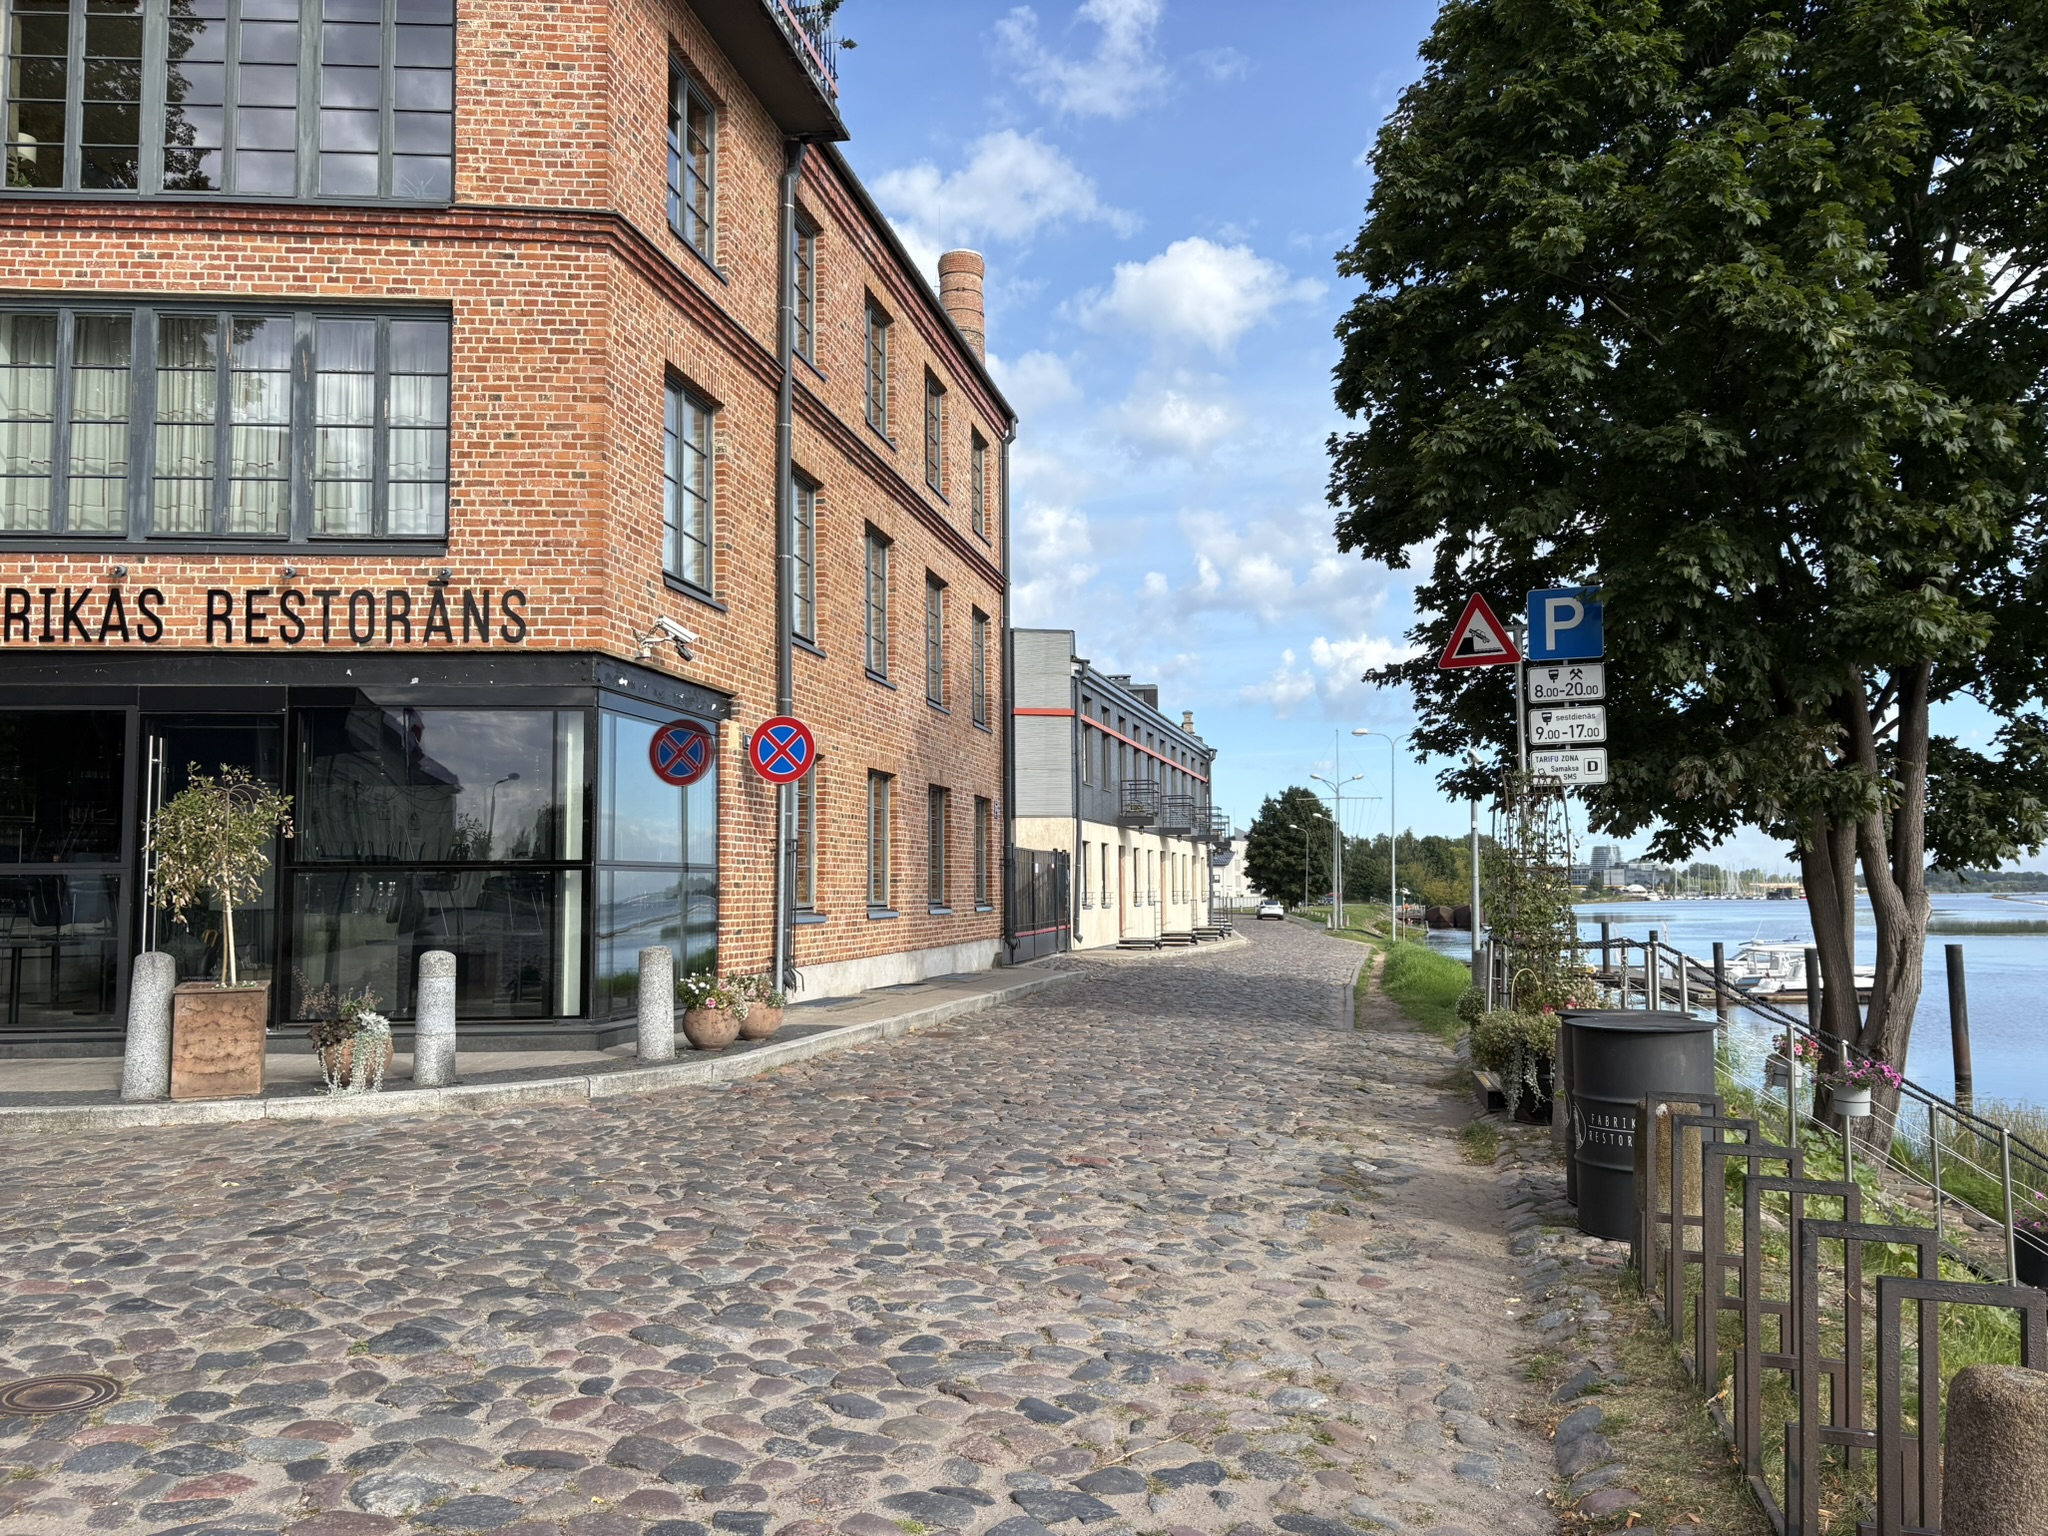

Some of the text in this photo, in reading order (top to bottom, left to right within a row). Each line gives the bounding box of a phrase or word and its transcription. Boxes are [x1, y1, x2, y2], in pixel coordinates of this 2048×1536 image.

[3, 580, 527, 644] RIKAS RESTORĀNS
[1545, 597, 1585, 651] P
[1555, 712, 1596, 721] sestdienās
[1587, 760, 1599, 772] D
[1589, 1130, 1632, 1147] RESTOR
